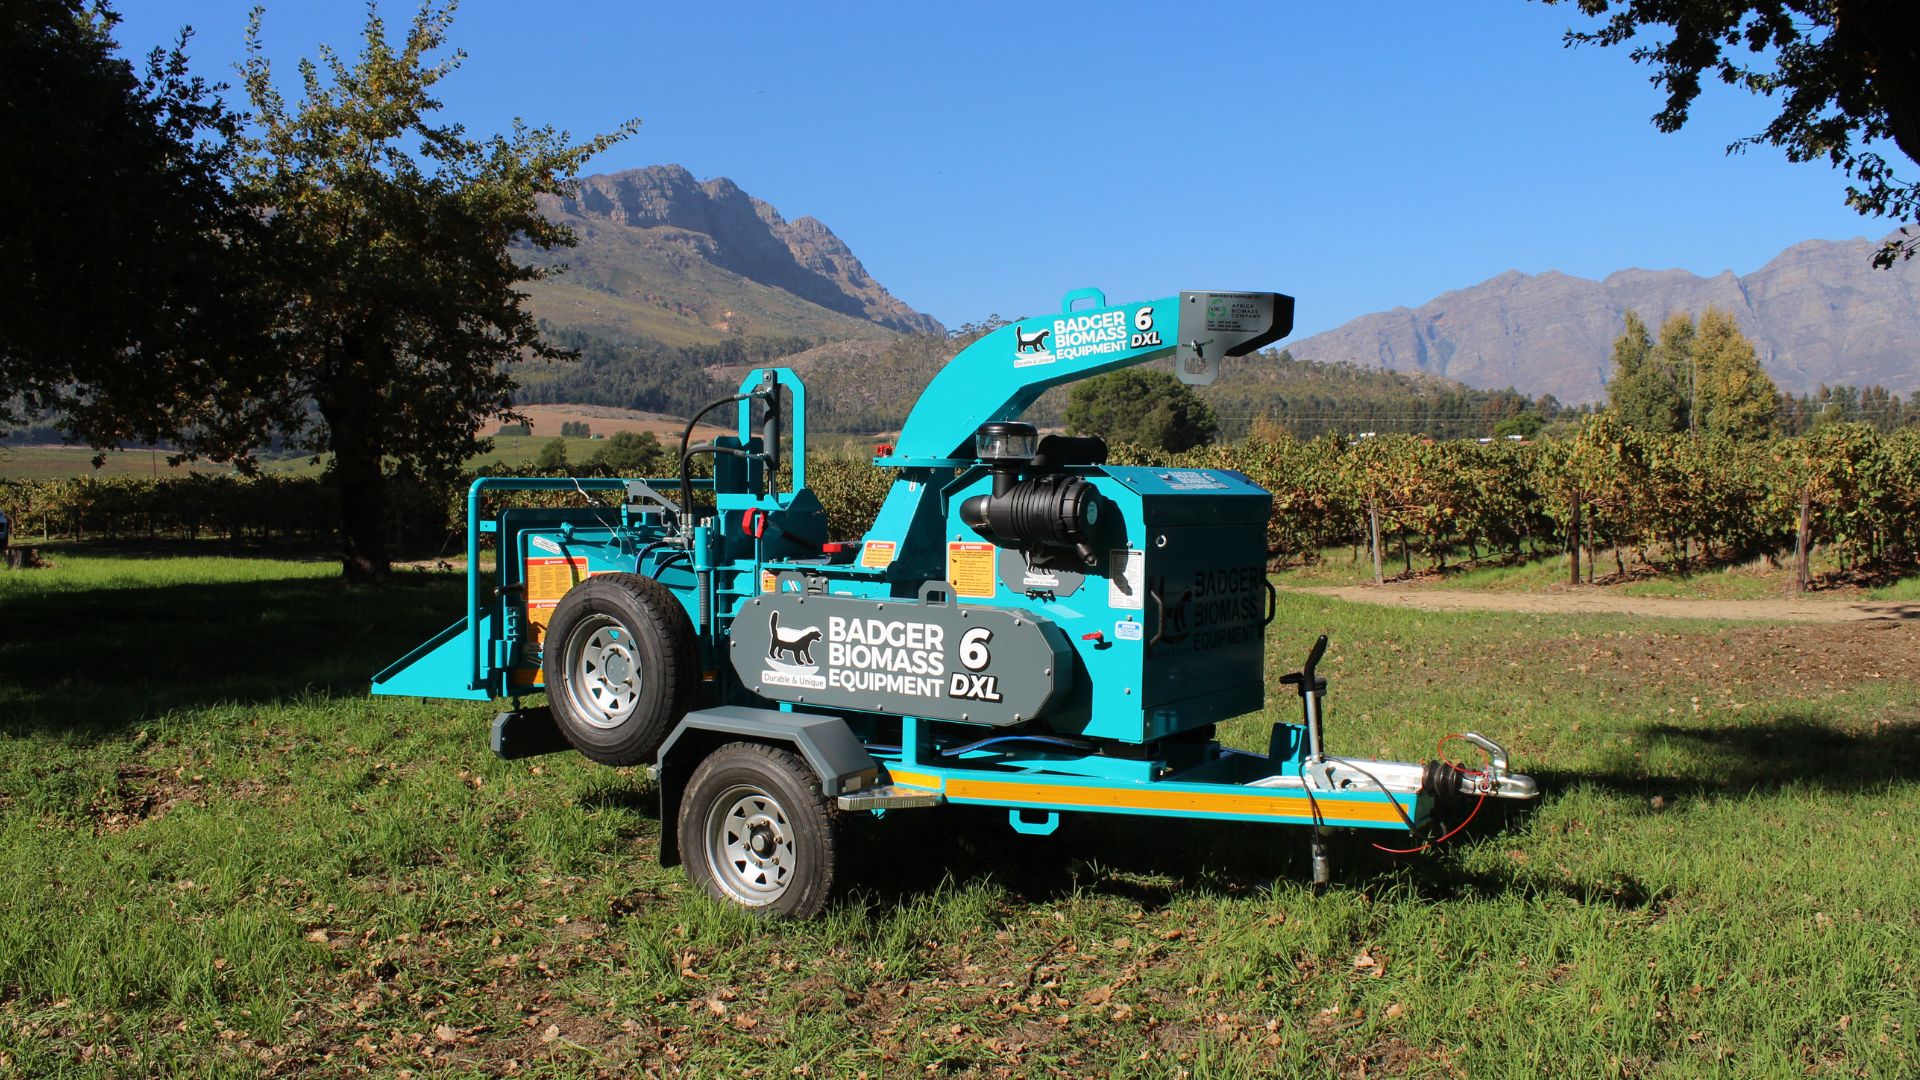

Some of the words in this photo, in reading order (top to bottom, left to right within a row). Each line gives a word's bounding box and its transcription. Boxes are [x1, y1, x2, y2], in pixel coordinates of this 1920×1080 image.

[1053, 311, 1126, 335] BADGER
[1133, 307, 1154, 332] 6
[1055, 324, 1127, 348] BIOMASS
[1056, 339, 1128, 360] EQUIPMENT
[1130, 331, 1163, 349] DXL
[1195, 566, 1258, 597] BADGER
[1194, 596, 1258, 627] BIOMASS
[829, 616, 944, 650] BADGER
[1193, 624, 1255, 651] EQUIPMENT
[829, 642, 944, 676] BIOMASS
[959, 627, 993, 672] 6
[764, 673, 790, 684] Durable
[791, 676, 798, 684] &
[799, 676, 824, 688] Unique
[829, 668, 944, 698] EQUIPMENT
[949, 672, 1003, 703] DXL
